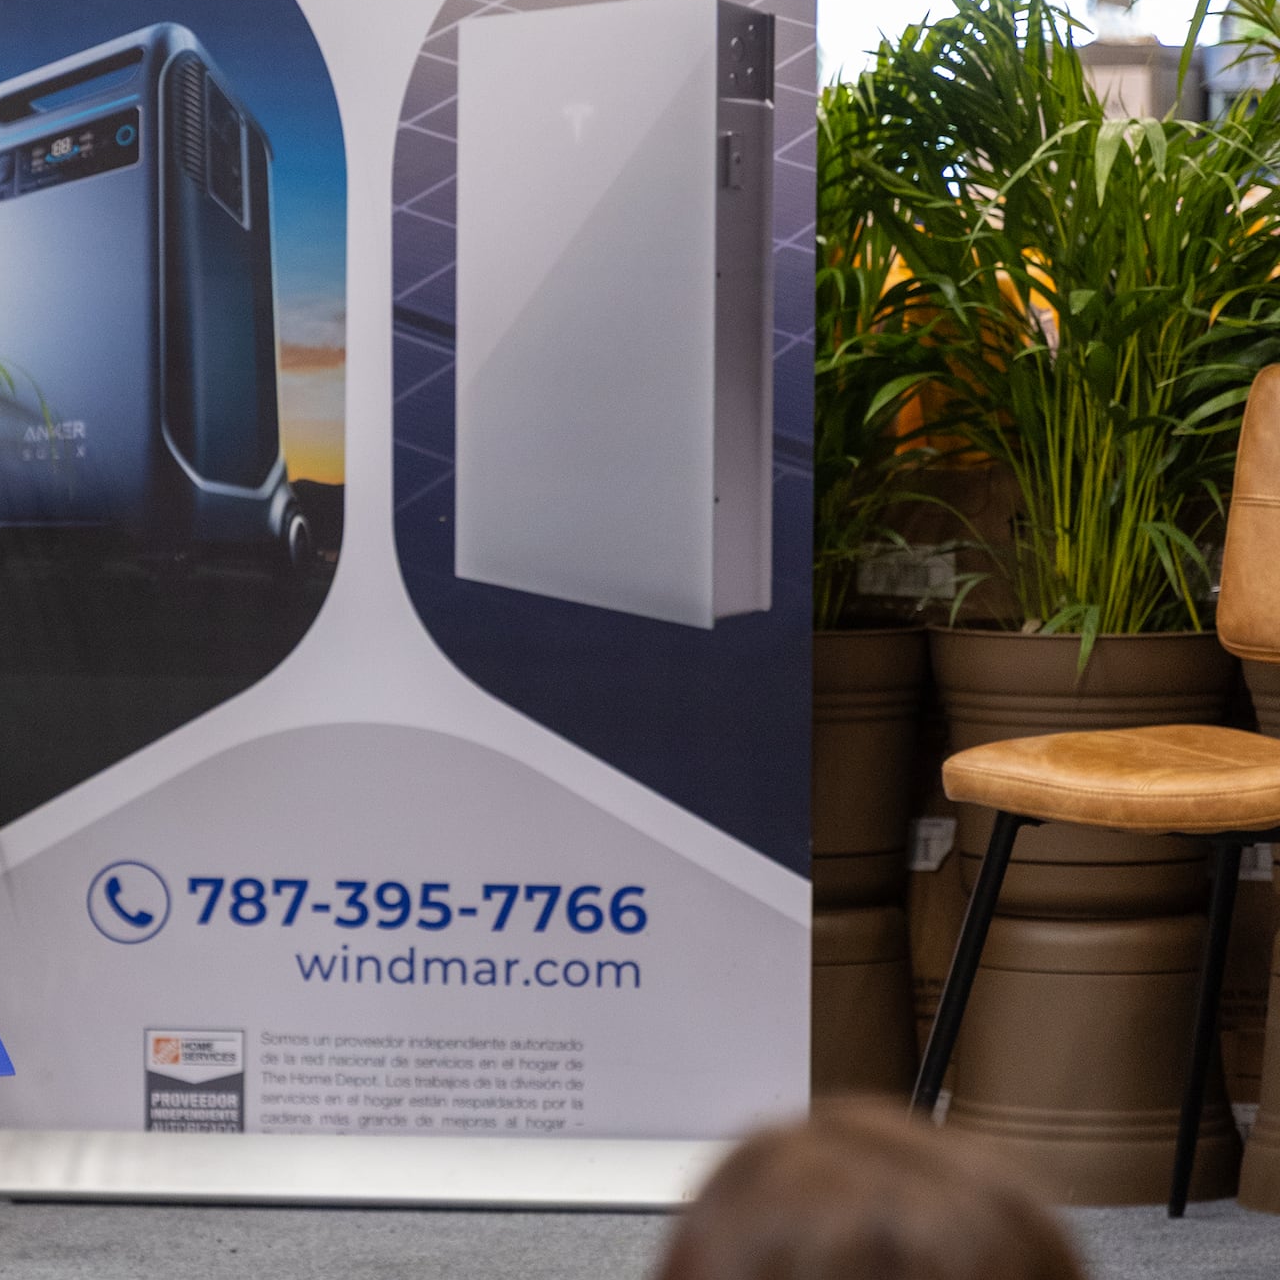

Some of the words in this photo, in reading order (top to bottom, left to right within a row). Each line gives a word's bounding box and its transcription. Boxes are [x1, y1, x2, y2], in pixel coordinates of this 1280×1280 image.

[187, 876, 649, 935] 787-395-7766
[295, 944, 642, 989] windmar.com
[260, 1031, 309, 1046] Somos
[313, 1035, 331, 1046] un
[334, 1035, 404, 1050] proveedor
[407, 1036, 506, 1052] independiente
[509, 1038, 583, 1052] autorizado
[328, 1054, 386, 1068] nacional
[413, 1058, 473, 1069] servicios
[518, 1057, 559, 1074] hogar
[261, 1071, 287, 1085] The
[289, 1073, 332, 1086] Home
[151, 1093, 239, 1108] PROVEEDOR
